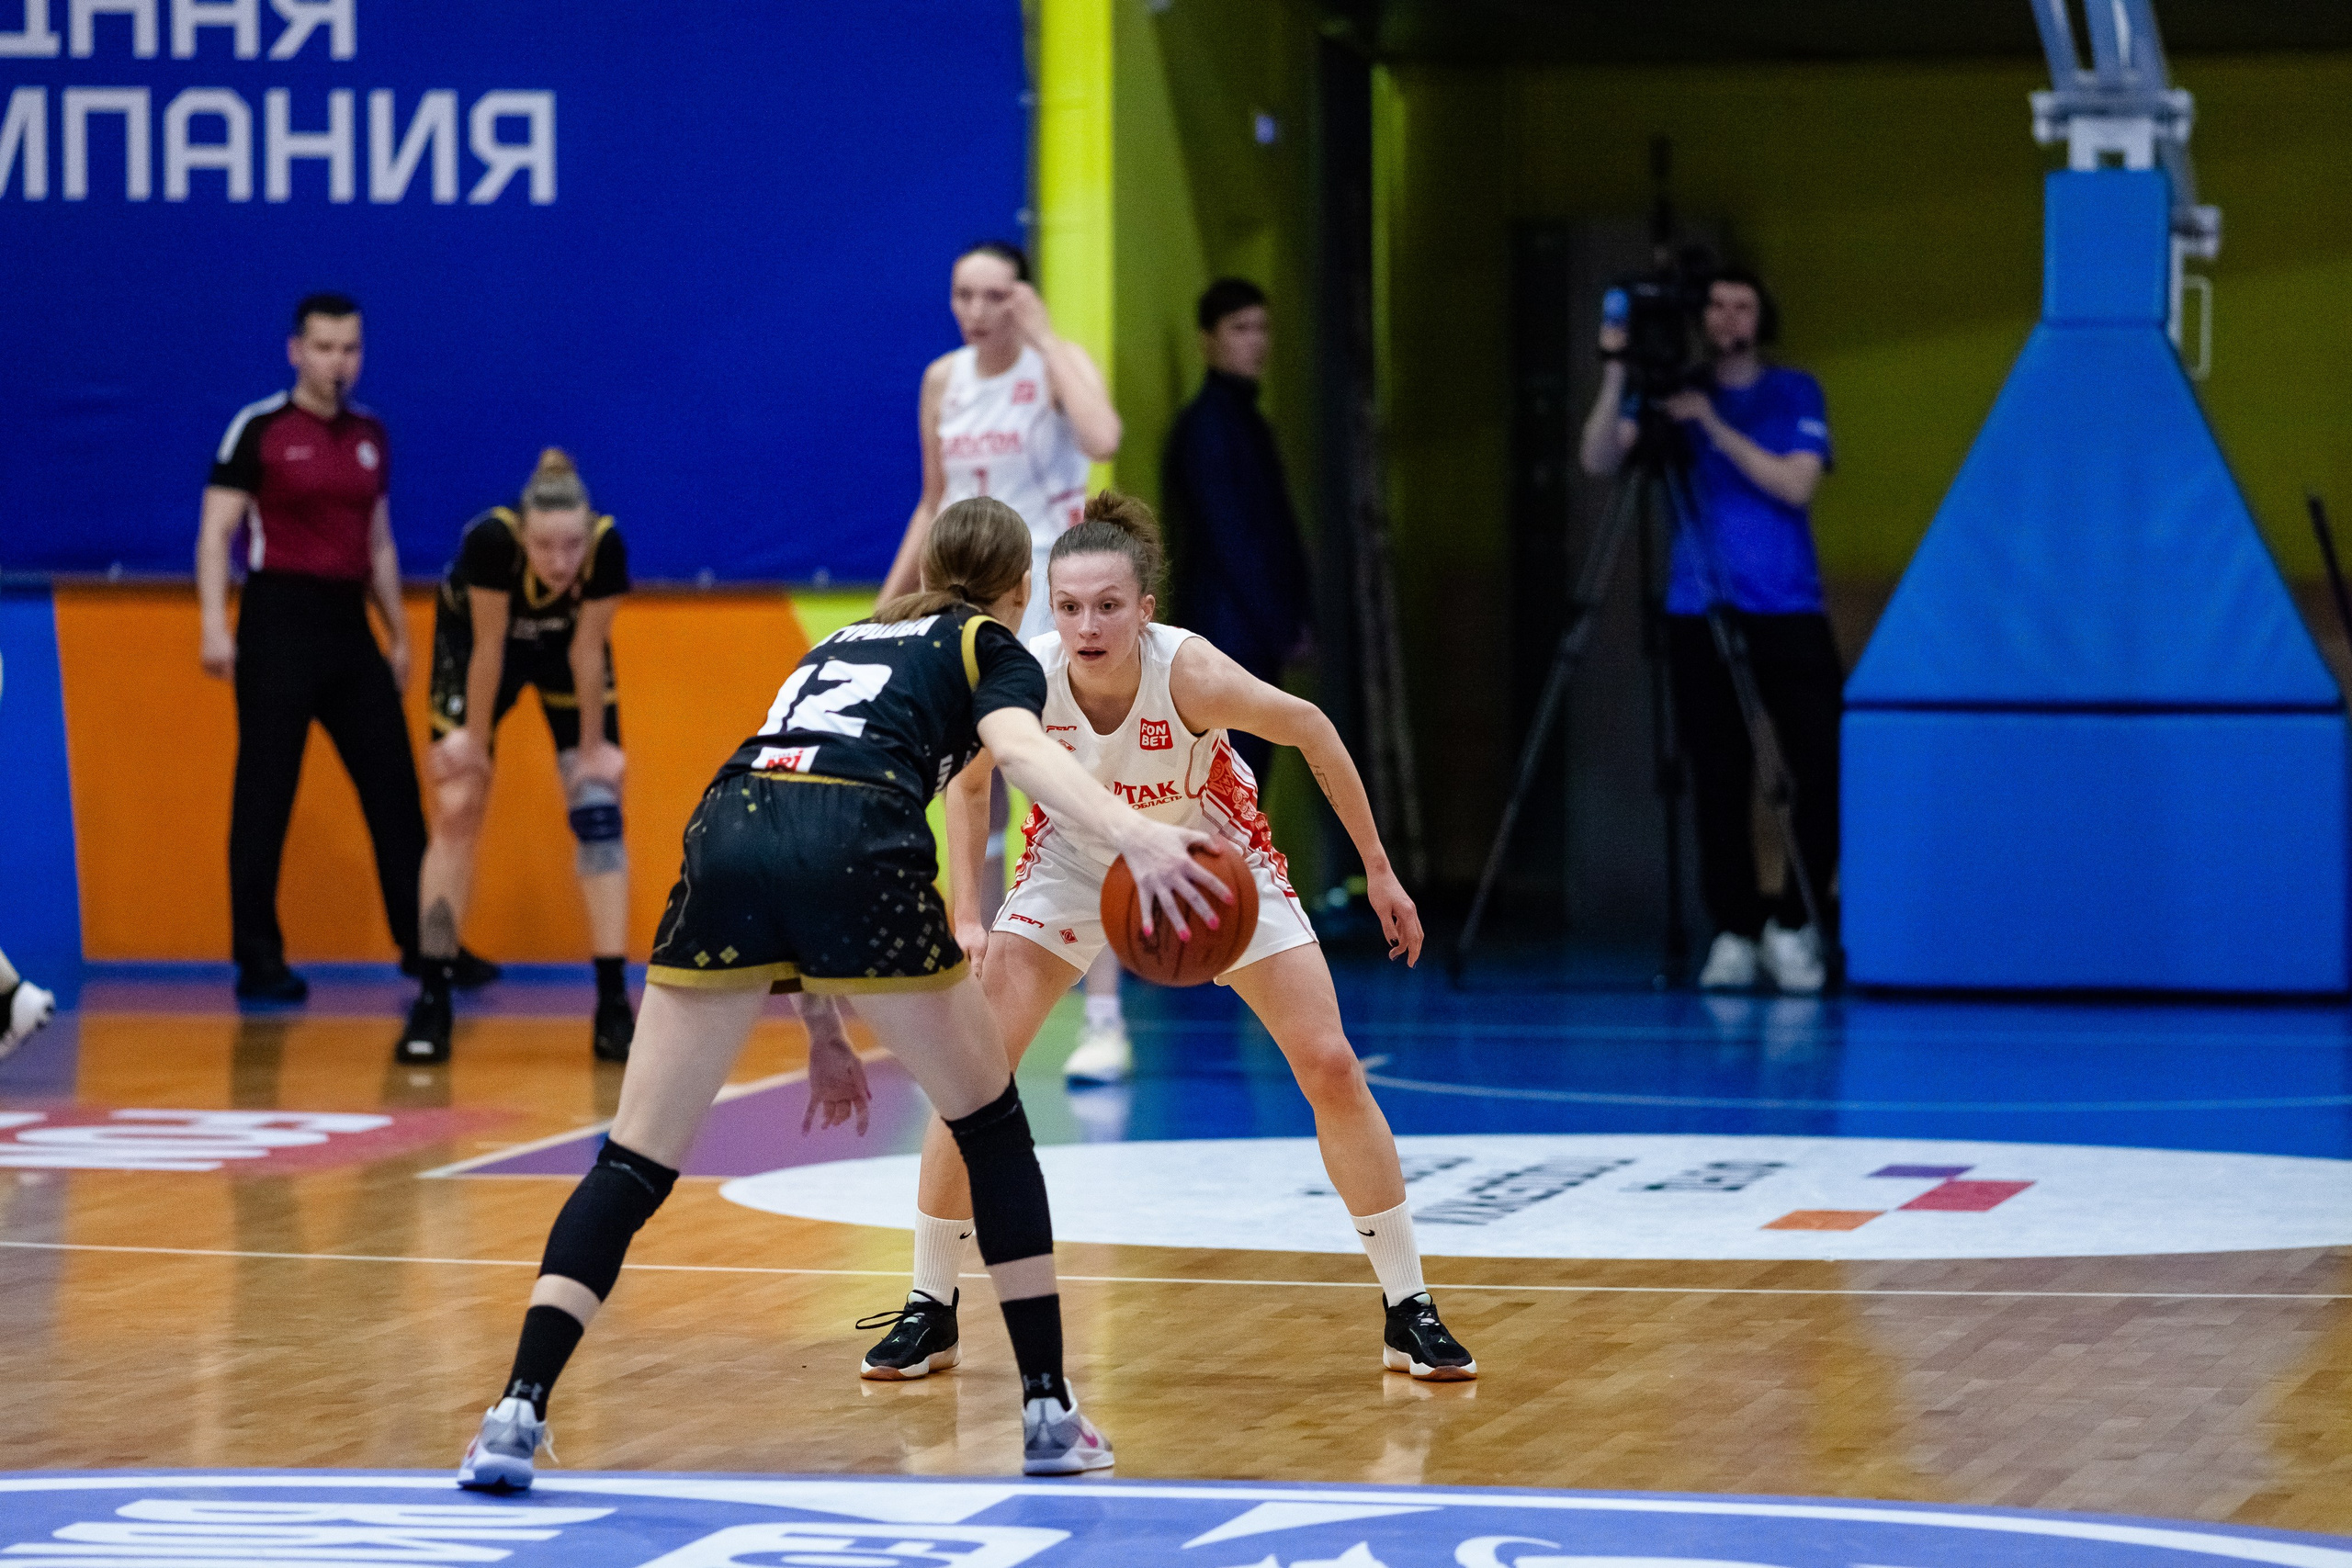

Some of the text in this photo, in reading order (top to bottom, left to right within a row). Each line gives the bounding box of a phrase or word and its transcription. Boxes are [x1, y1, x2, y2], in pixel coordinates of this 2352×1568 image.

[757, 660, 892, 738] 12
[1141, 722, 1166, 736] FON
[1141, 734, 1169, 747] BET
[1109, 780, 1180, 805] РТАК
[1132, 795, 1182, 810] ОБЛАСТЬ
